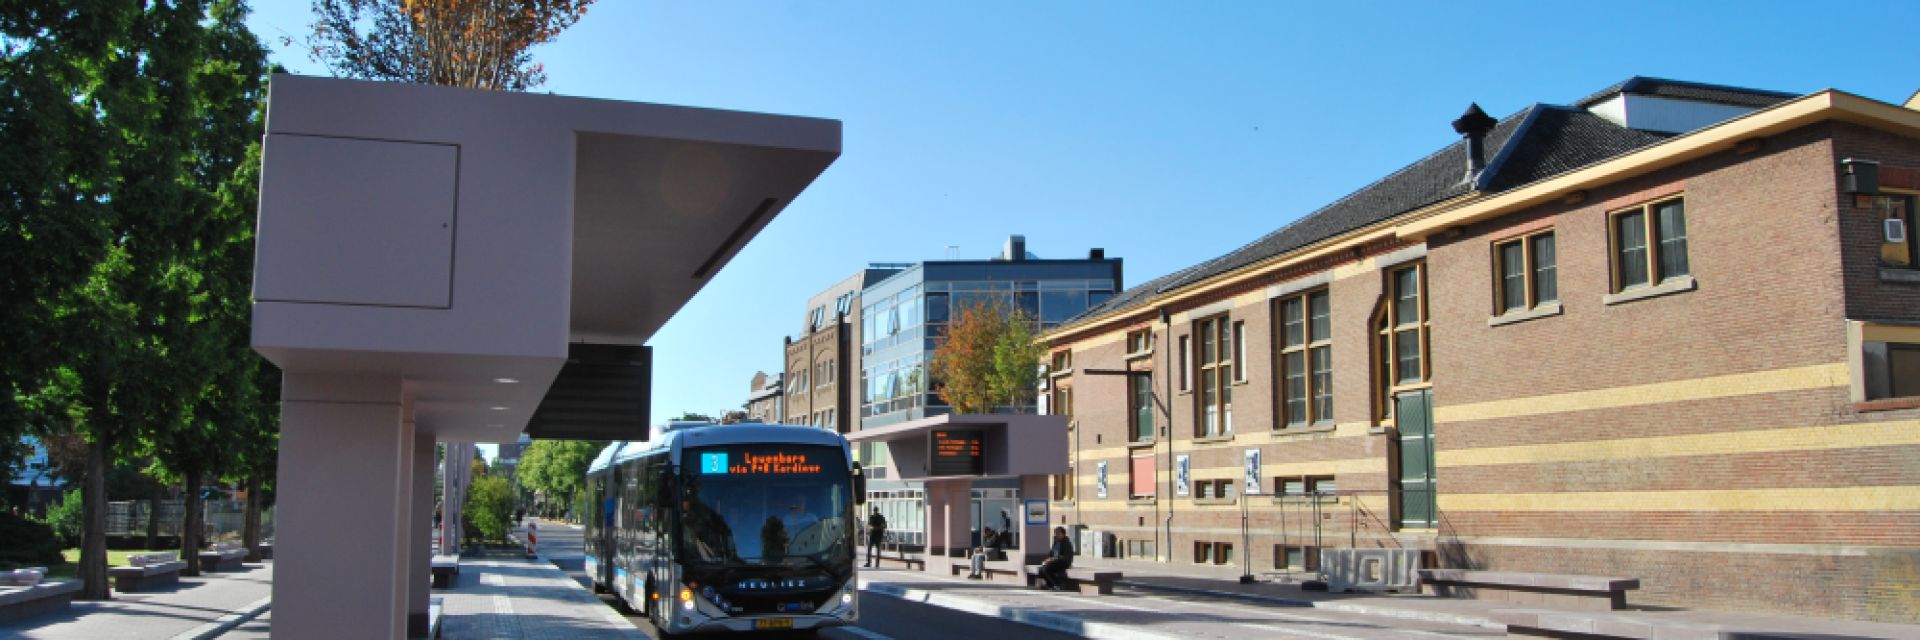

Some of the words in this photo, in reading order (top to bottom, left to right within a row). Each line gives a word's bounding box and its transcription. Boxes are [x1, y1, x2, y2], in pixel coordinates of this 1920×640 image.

[711, 454, 720, 472] 3
[729, 464, 748, 474] via
[738, 580, 806, 589] HEULIEZ
